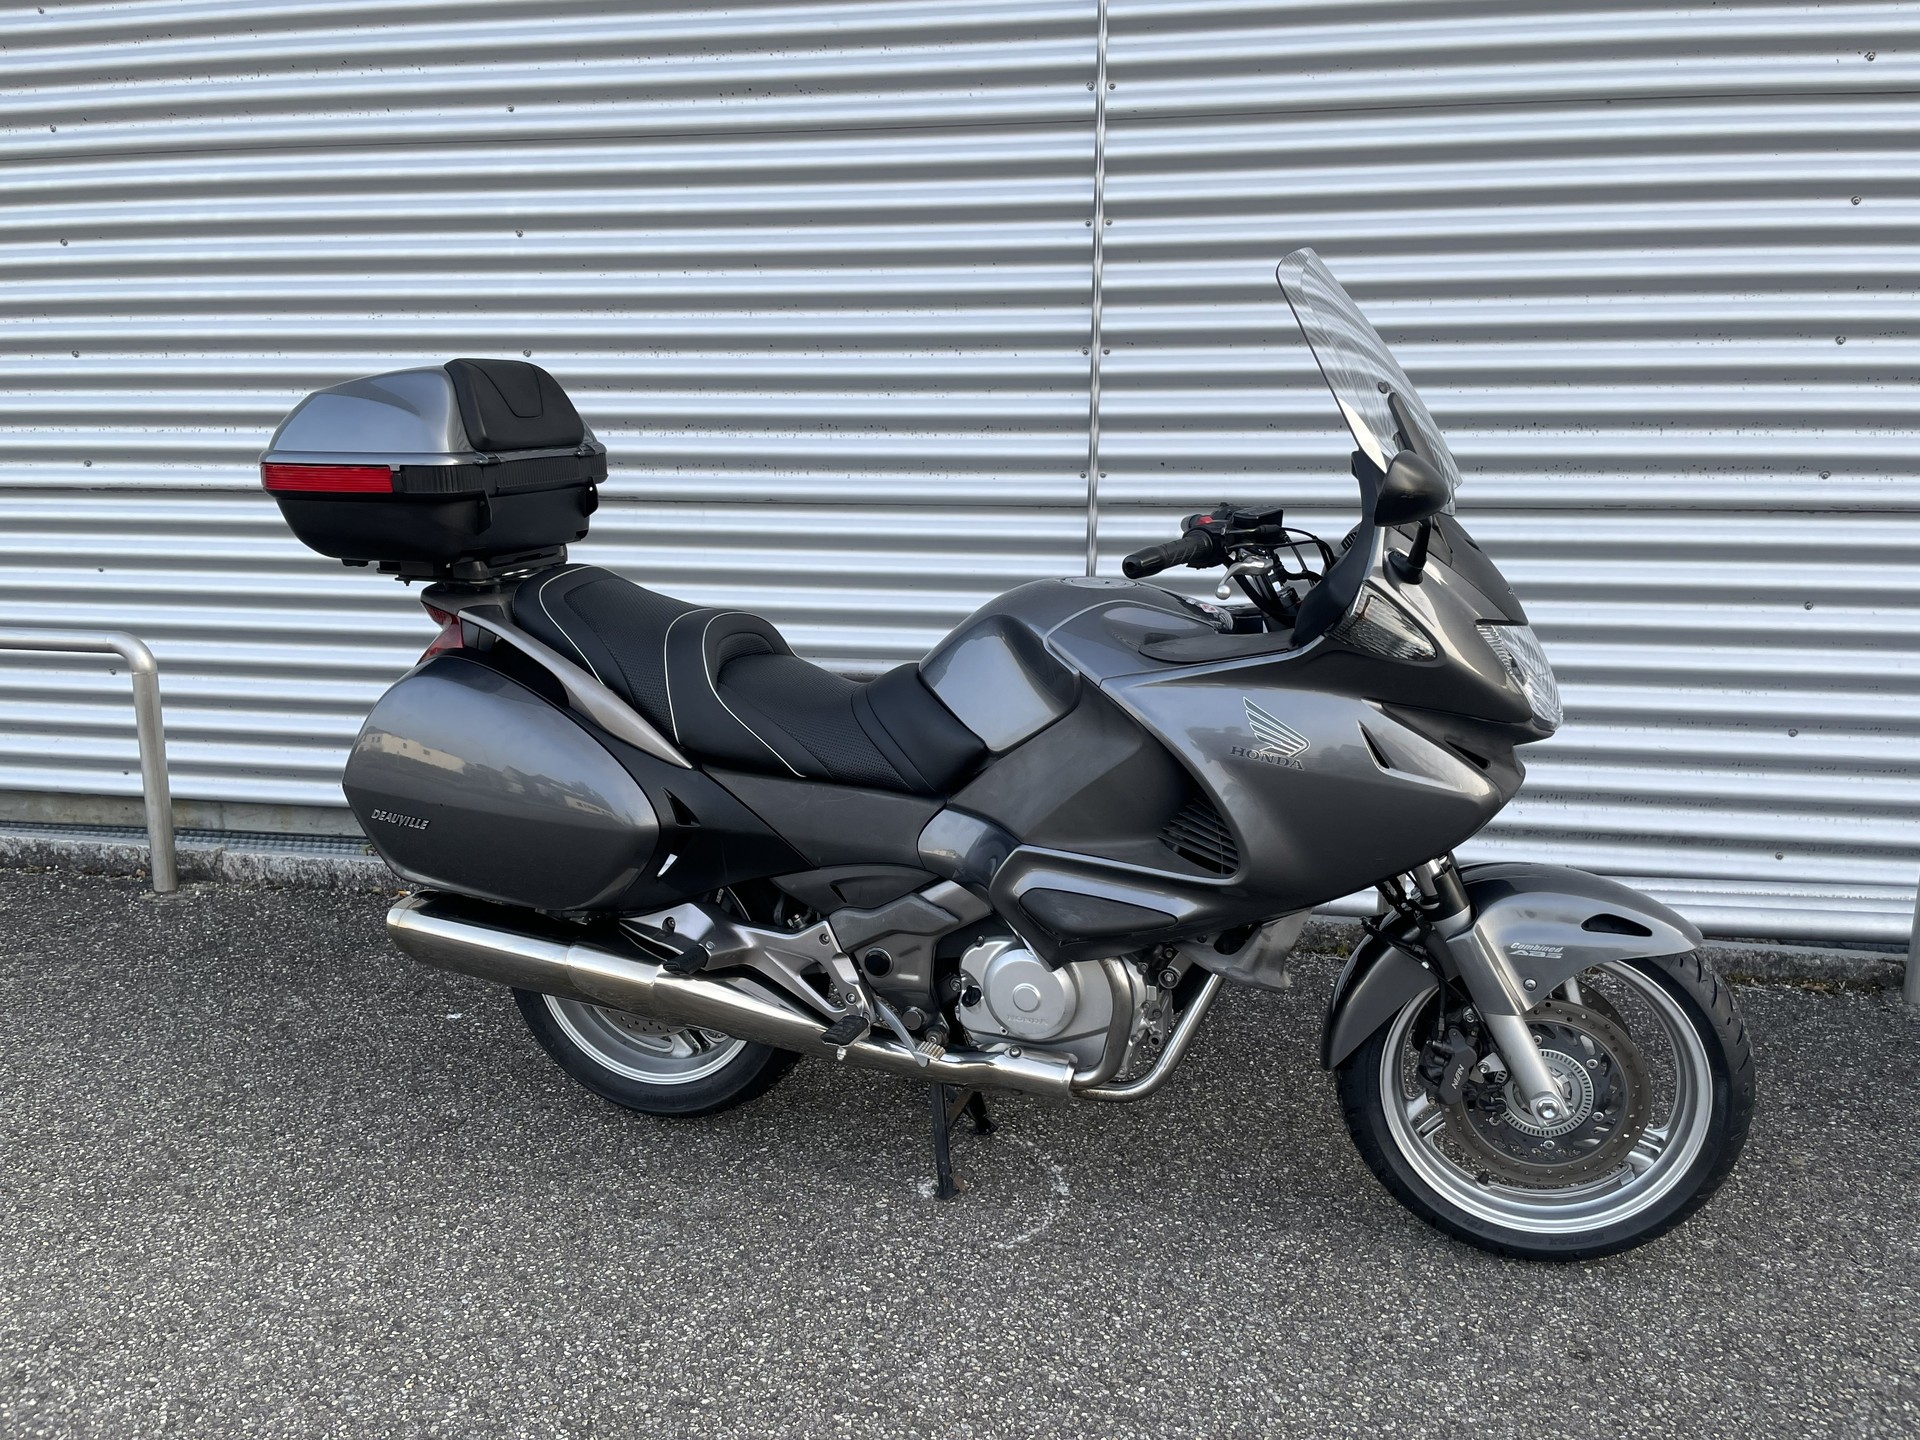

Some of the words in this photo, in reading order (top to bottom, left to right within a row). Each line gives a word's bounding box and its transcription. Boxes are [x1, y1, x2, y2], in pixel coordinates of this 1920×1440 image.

[1230, 746, 1304, 770] HONDA
[371, 808, 429, 830] DEAUVILLE
[1509, 950, 1563, 959] ABS
[1510, 942, 1564, 953] Combined
